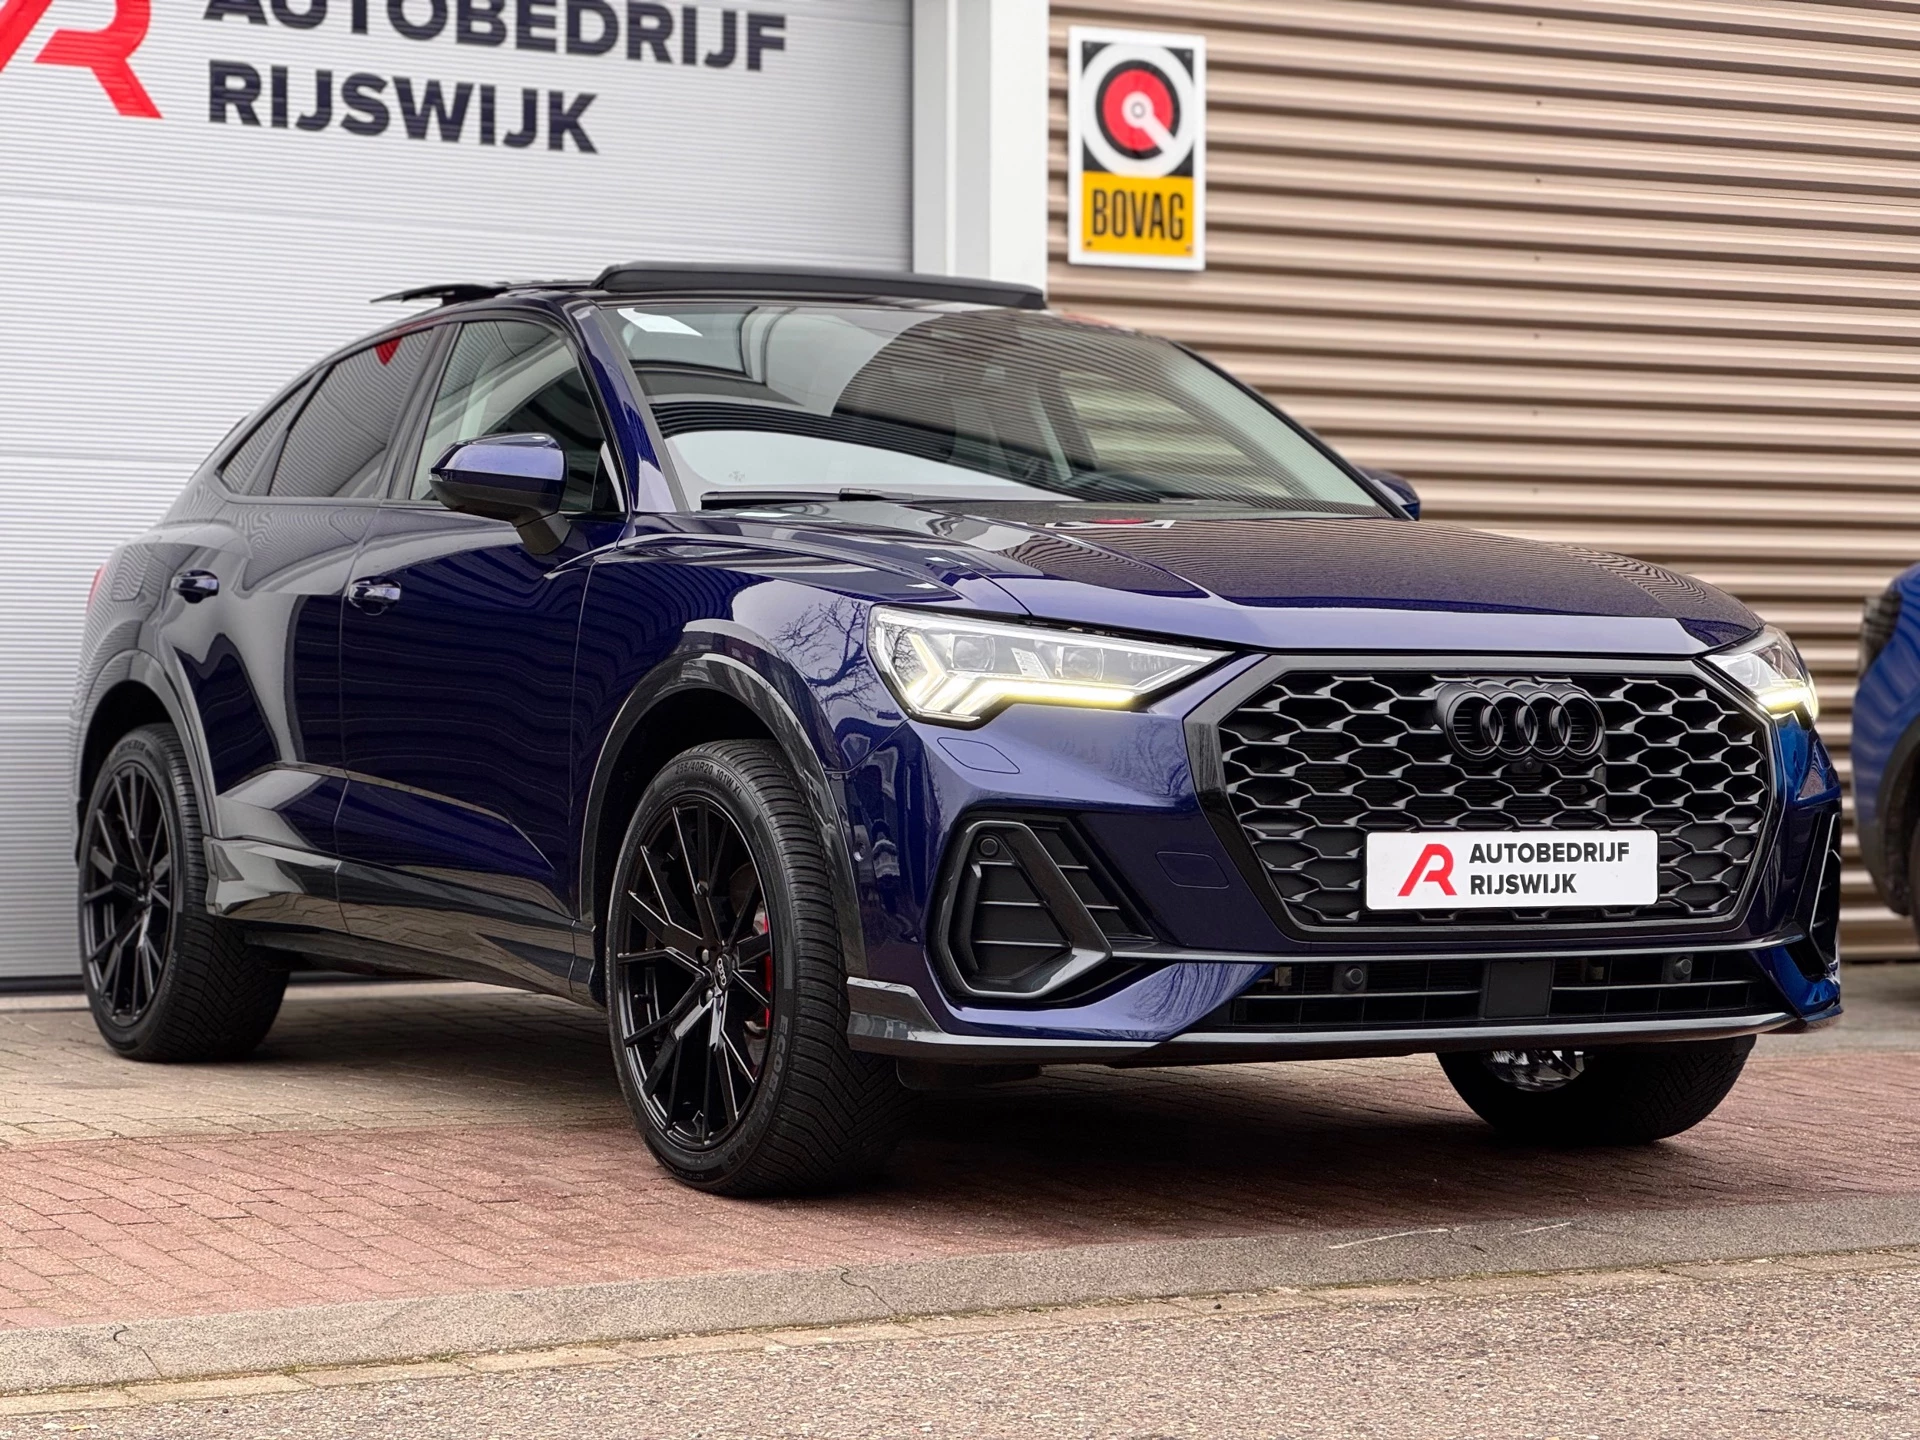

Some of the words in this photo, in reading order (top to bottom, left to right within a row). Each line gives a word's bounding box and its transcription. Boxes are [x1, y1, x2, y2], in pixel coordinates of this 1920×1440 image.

[208, 59, 599, 154] RIJSWIJK
[1092, 188, 1185, 241] BOVAG
[1469, 842, 1629, 863] AUTOBEDRIJF
[1470, 873, 1578, 895] RIJSWIJK
